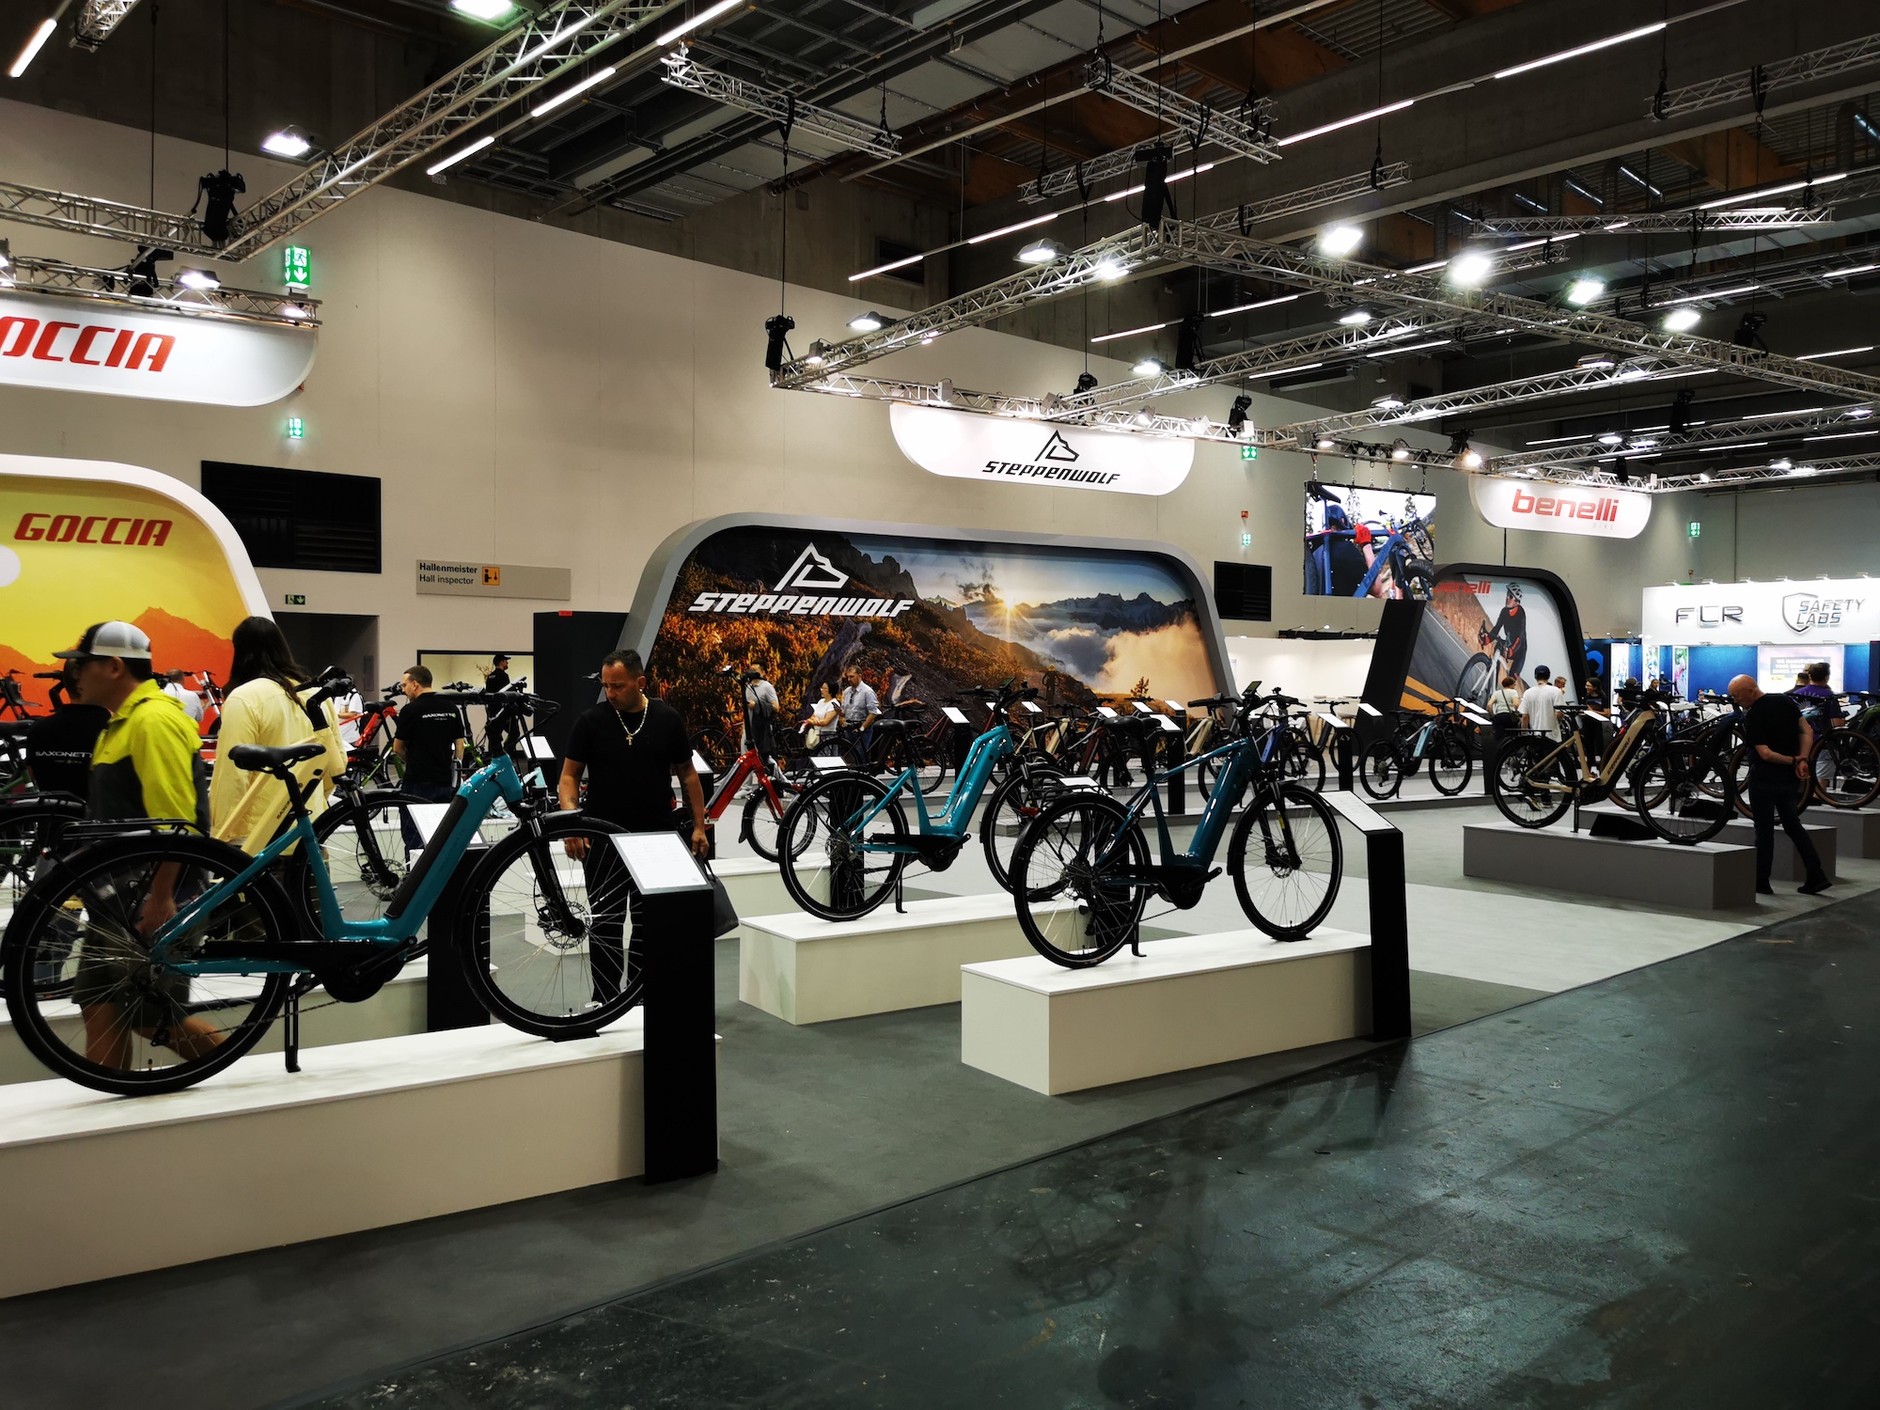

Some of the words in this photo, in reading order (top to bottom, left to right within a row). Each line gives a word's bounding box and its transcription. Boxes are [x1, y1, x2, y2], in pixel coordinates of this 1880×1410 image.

[0, 316, 176, 372] OCCIA
[1512, 489, 1619, 522] benelli
[14, 513, 173, 546] GOCCIA
[419, 562, 478, 574] Hallenmeister
[419, 574, 435, 582] Hall
[437, 574, 474, 585] inspector
[1799, 598, 1865, 613] SAFETY
[1676, 605, 1744, 627] FLR
[1796, 612, 1841, 625] LABS
